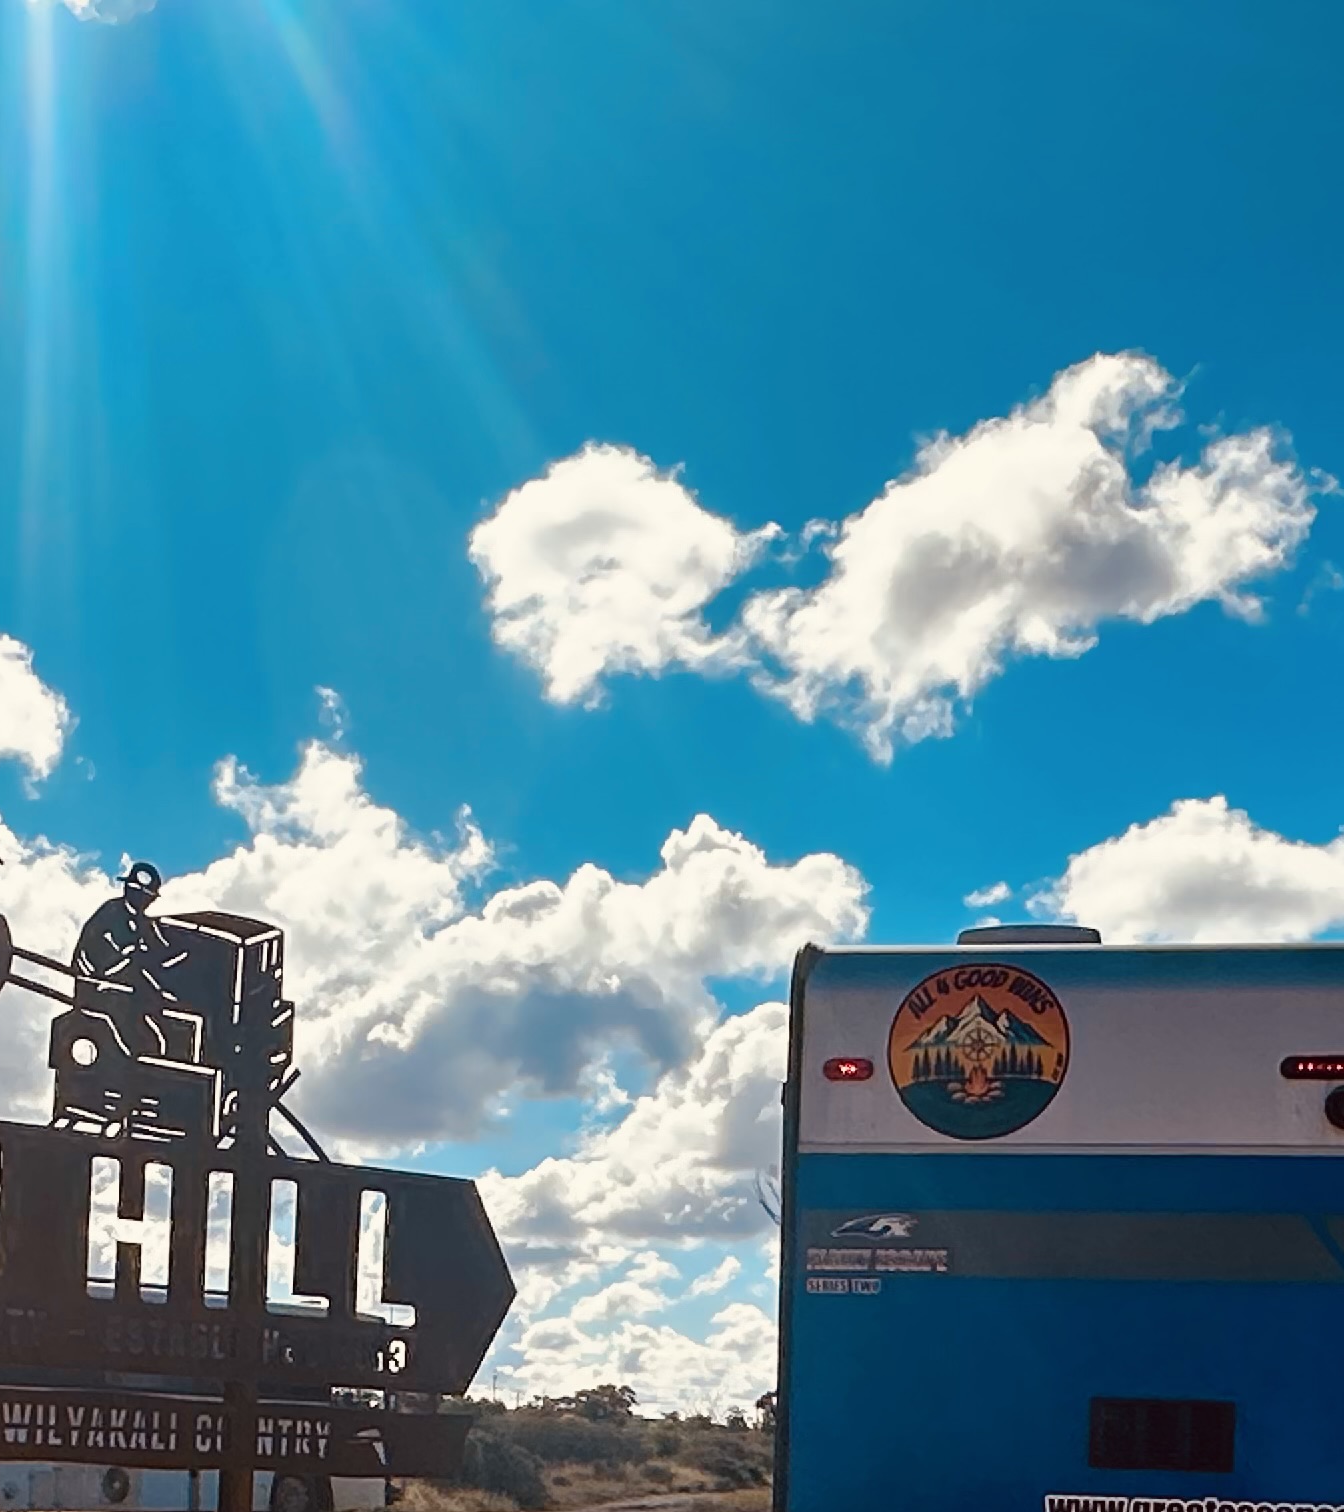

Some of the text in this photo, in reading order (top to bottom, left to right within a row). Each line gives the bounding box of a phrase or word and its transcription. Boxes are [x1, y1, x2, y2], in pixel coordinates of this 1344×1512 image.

[953, 969, 1009, 992] GOOD
[86, 1156, 417, 1328] HILL
[2, 1402, 178, 1450] WILYAKALI
[195, 1414, 331, 1458] CNTRY
